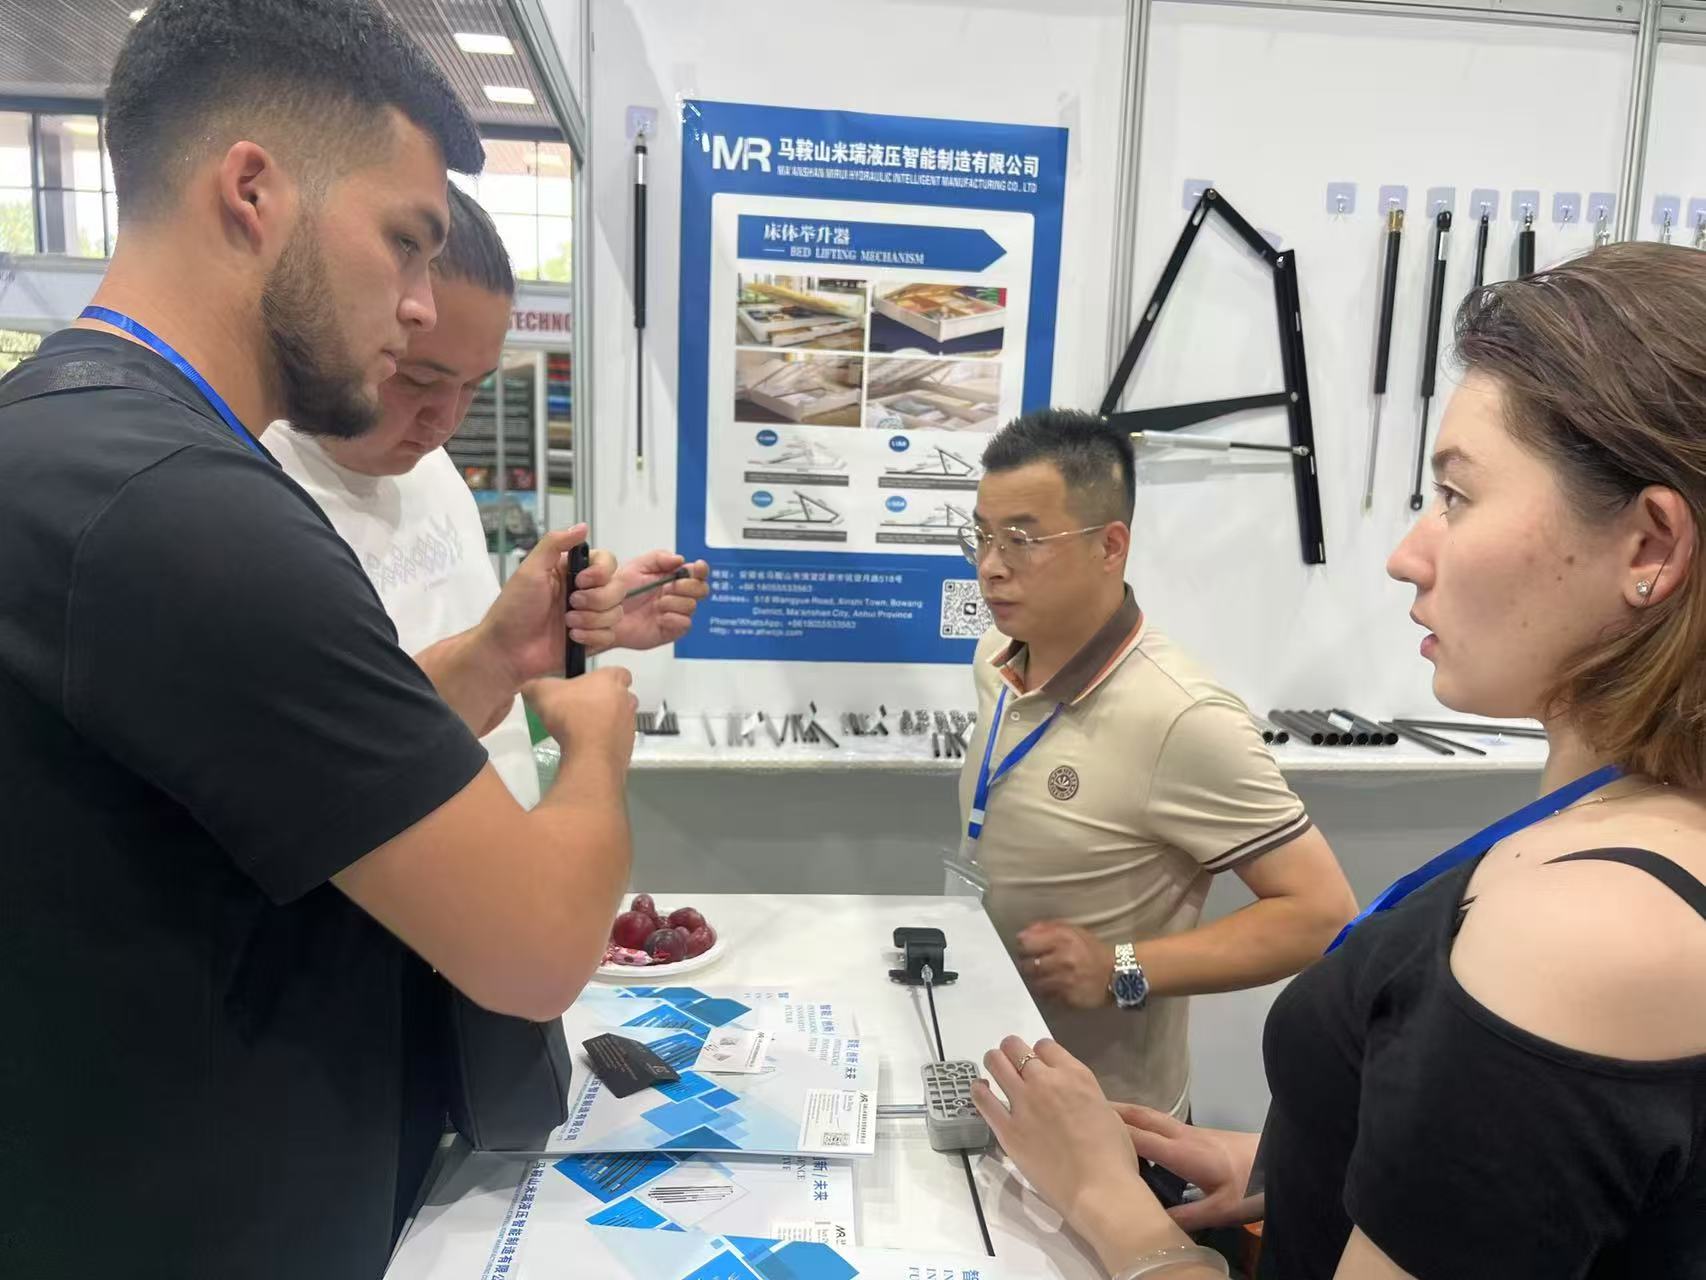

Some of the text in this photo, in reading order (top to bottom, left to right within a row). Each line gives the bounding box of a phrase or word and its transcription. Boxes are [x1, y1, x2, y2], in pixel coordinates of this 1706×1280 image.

[777, 137, 1040, 178] 马鞍山米瑞液压智能制造有限公司
[849, 170, 892, 183] HYDRAULIC
[893, 173, 941, 186] INTELLIGENT
[941, 176, 1006, 191] MANUFACTURING
[763, 222, 850, 246] 床体举升器
[790, 246, 925, 265] BED LIFTING MECHANISM
[811, 1157, 829, 1201] 新/未来
